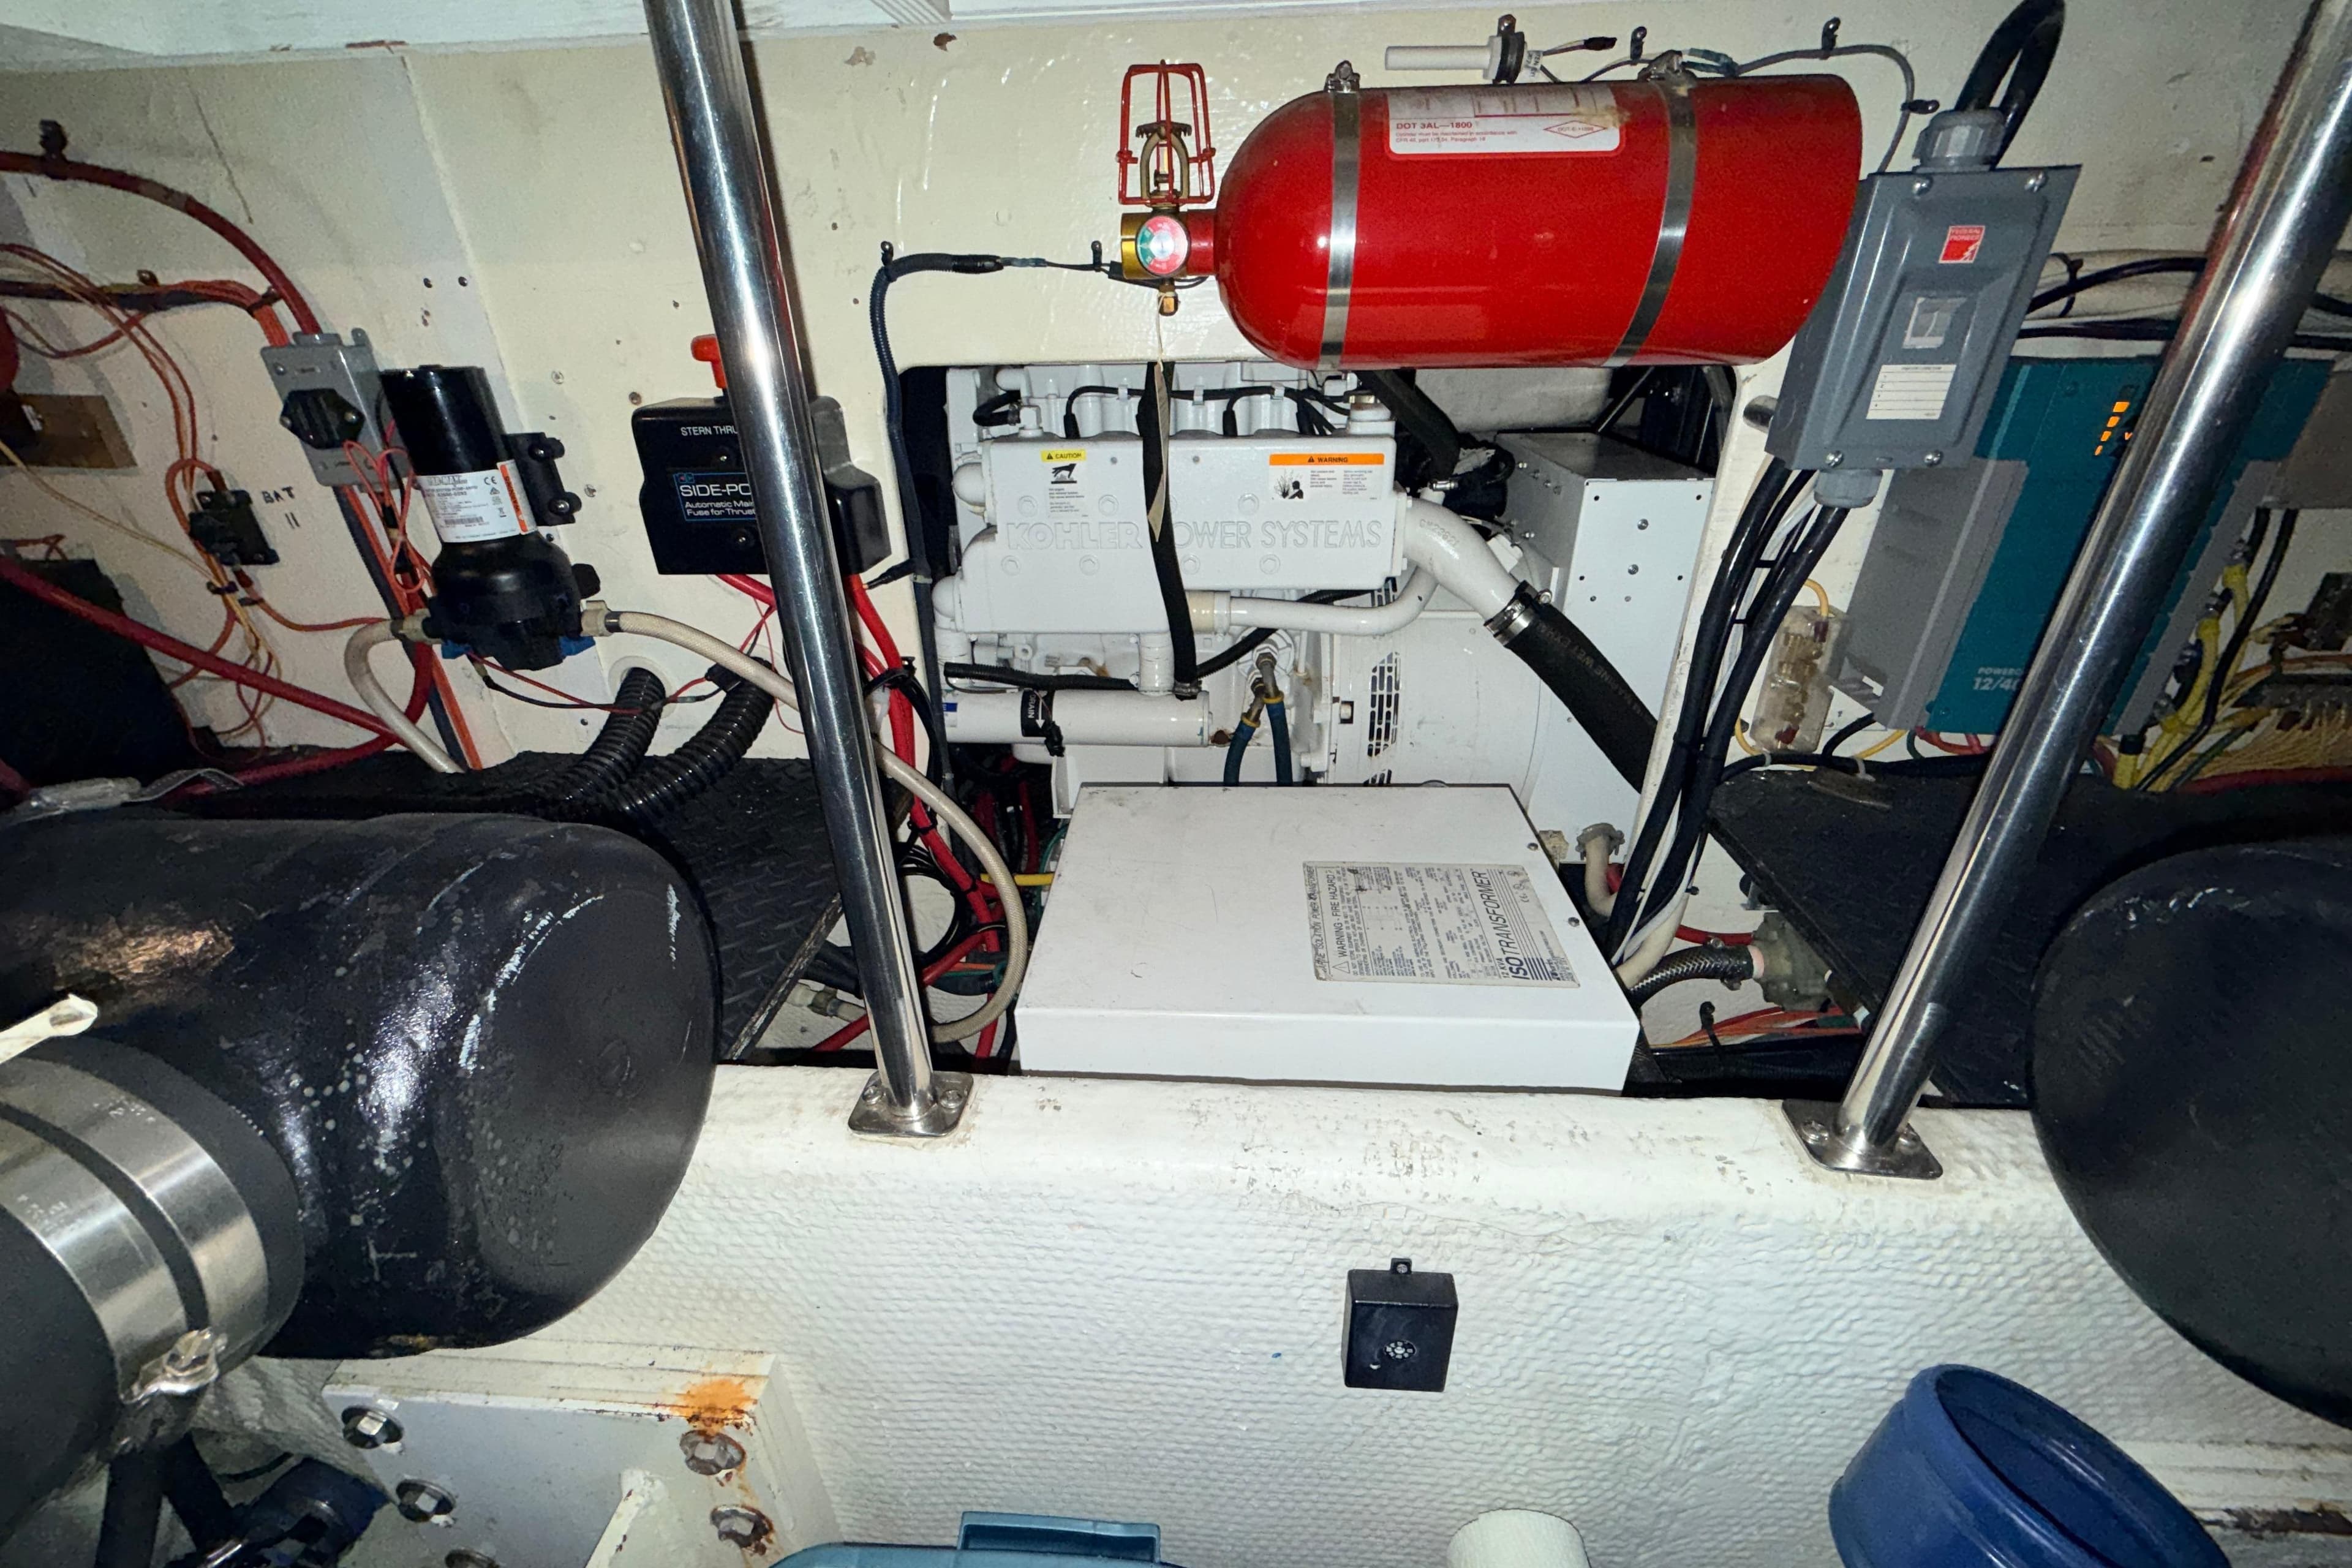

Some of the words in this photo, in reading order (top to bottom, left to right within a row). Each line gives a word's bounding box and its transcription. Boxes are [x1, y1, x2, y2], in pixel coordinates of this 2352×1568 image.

[680, 426, 712, 437] STERN
[713, 425, 738, 435] THRU
[262, 486, 295, 504] BAT
[680, 483, 752, 497] SIDE-PO
[685, 500, 733, 509] Automatic
[1006, 522, 1144, 550] KOHLER
[1172, 521, 1252, 549] OWER
[1261, 520, 1382, 549] SYSTEMS
[1027, 694, 1036, 719] DRAIN
[1327, 874, 1338, 900] HAZARD
[1330, 902, 1340, 916] FIRE
[1334, 922, 1348, 957] WARNING
[1495, 958, 1506, 970] KVA
